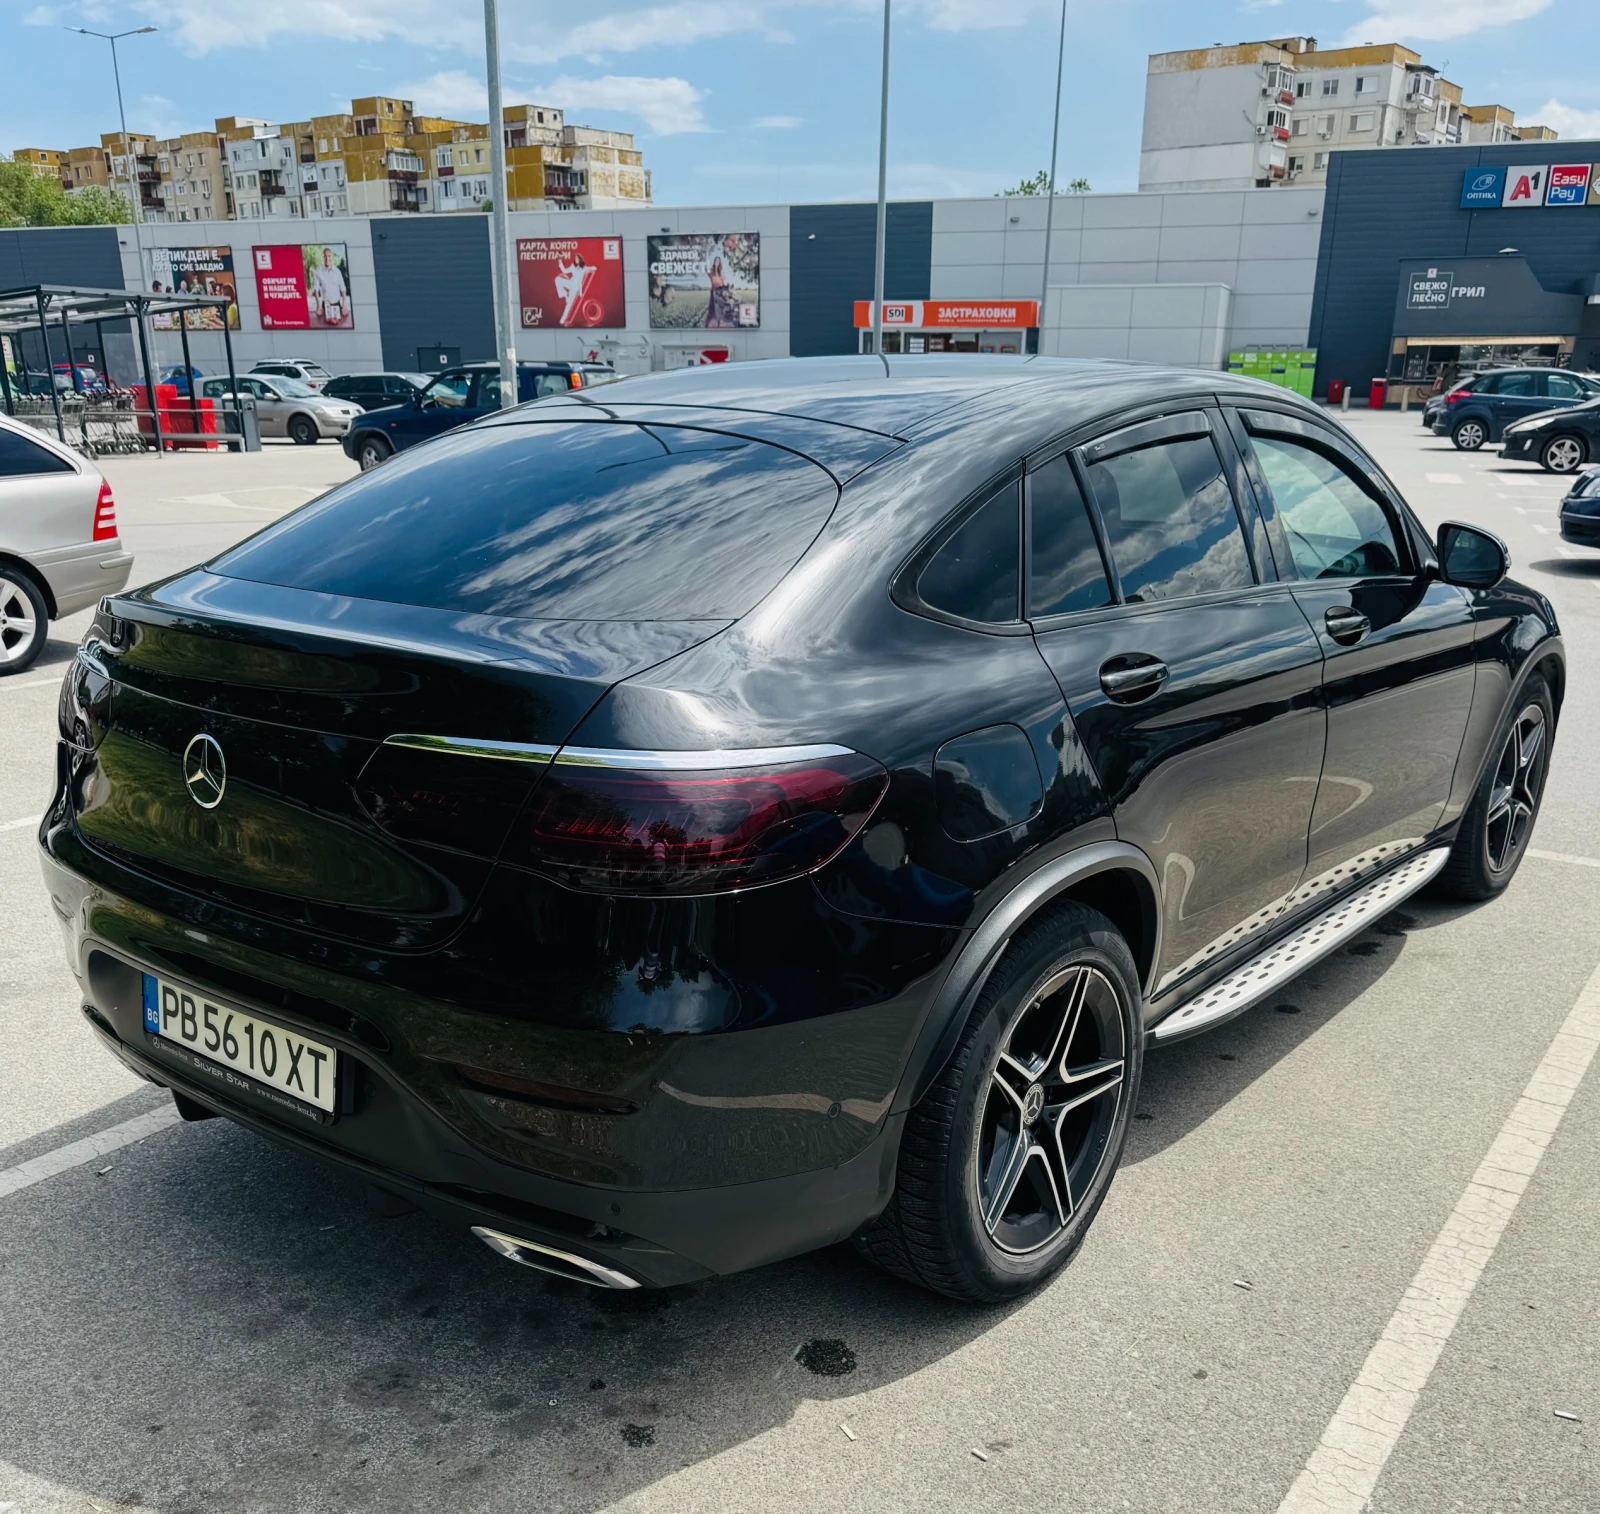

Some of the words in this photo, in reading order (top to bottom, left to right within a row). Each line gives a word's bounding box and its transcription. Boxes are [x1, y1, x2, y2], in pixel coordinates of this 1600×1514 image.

[1510, 171, 1541, 201] A1
[1552, 173, 1586, 187] Easy
[1551, 187, 1575, 200] Pay
[520, 242, 548, 251] КАРТА,
[550, 241, 578, 250] КОЯТО
[153, 249, 209, 263] ВЕЛИКДЕН
[520, 251, 547, 261] ПЕСТИ
[195, 263, 224, 272] ЗАЕДНО
[650, 260, 711, 274] СВЕЖЕСТ!
[1413, 282, 1448, 291] СВЕЖО
[1451, 286, 1486, 298] ГРИЛ
[1412, 293, 1446, 303] ЛЕСНО
[888, 309, 904, 318] SDI
[938, 307, 1016, 319] ЗАСТРАХОВКИ
[147, 1008, 158, 1024] BG
